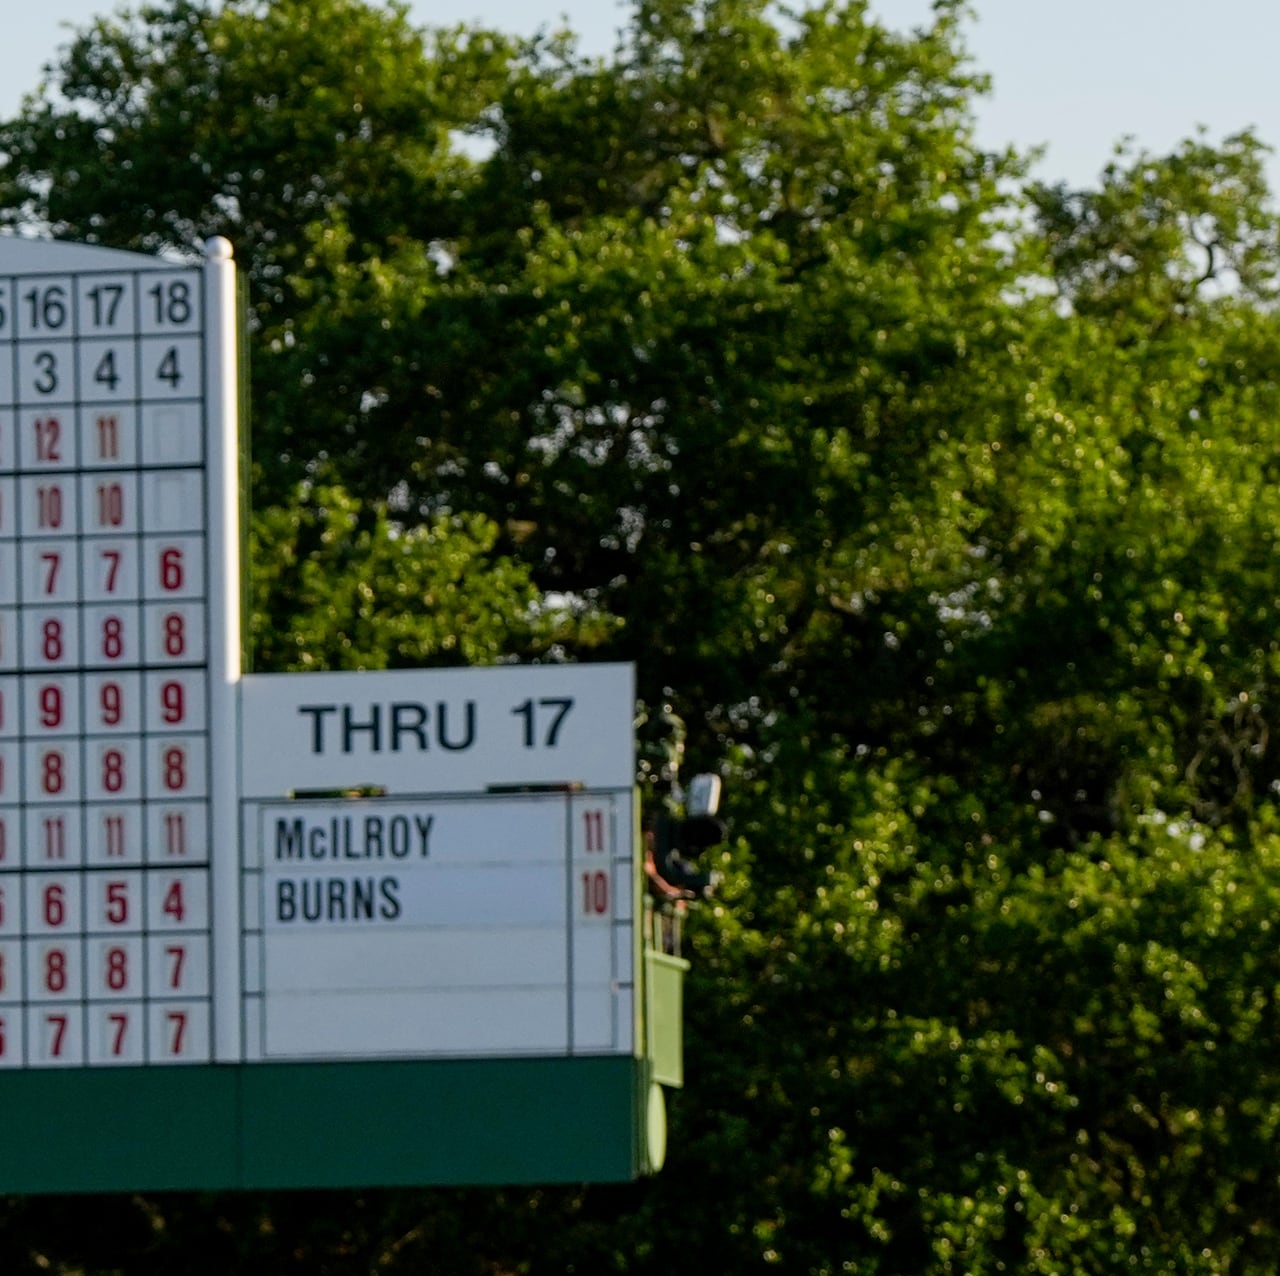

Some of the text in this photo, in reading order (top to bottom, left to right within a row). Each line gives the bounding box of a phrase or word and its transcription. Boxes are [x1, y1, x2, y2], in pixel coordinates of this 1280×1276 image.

[25, 286, 66, 330] 16
[87, 283, 125, 327] 17
[149, 281, 191, 325] 18
[33, 350, 59, 396] 3
[93, 349, 120, 391] 4
[156, 346, 183, 389] 4
[35, 418, 61, 463] 12
[37, 485, 63, 529] 10
[40, 551, 62, 594] 7
[160, 548, 185, 592] 6
[41, 618, 64, 662] 8
[163, 613, 186, 658] 8
[39, 684, 64, 729] 9
[161, 681, 186, 725] 9
[298, 698, 575, 755] THRU 17
[42, 750, 65, 795] 8
[163, 745, 186, 792] 8
[42, 817, 65, 858] 11
[163, 811, 187, 855] 11
[276, 810, 604, 860] McILROY 11
[42, 883, 66, 928] 6
[163, 880, 186, 921] 4
[277, 870, 608, 922] BURNS 10
[44, 948, 67, 993] 8
[166, 944, 188, 990] 7
[47, 1014, 69, 1057] 7
[167, 1010, 188, 1055] 7
